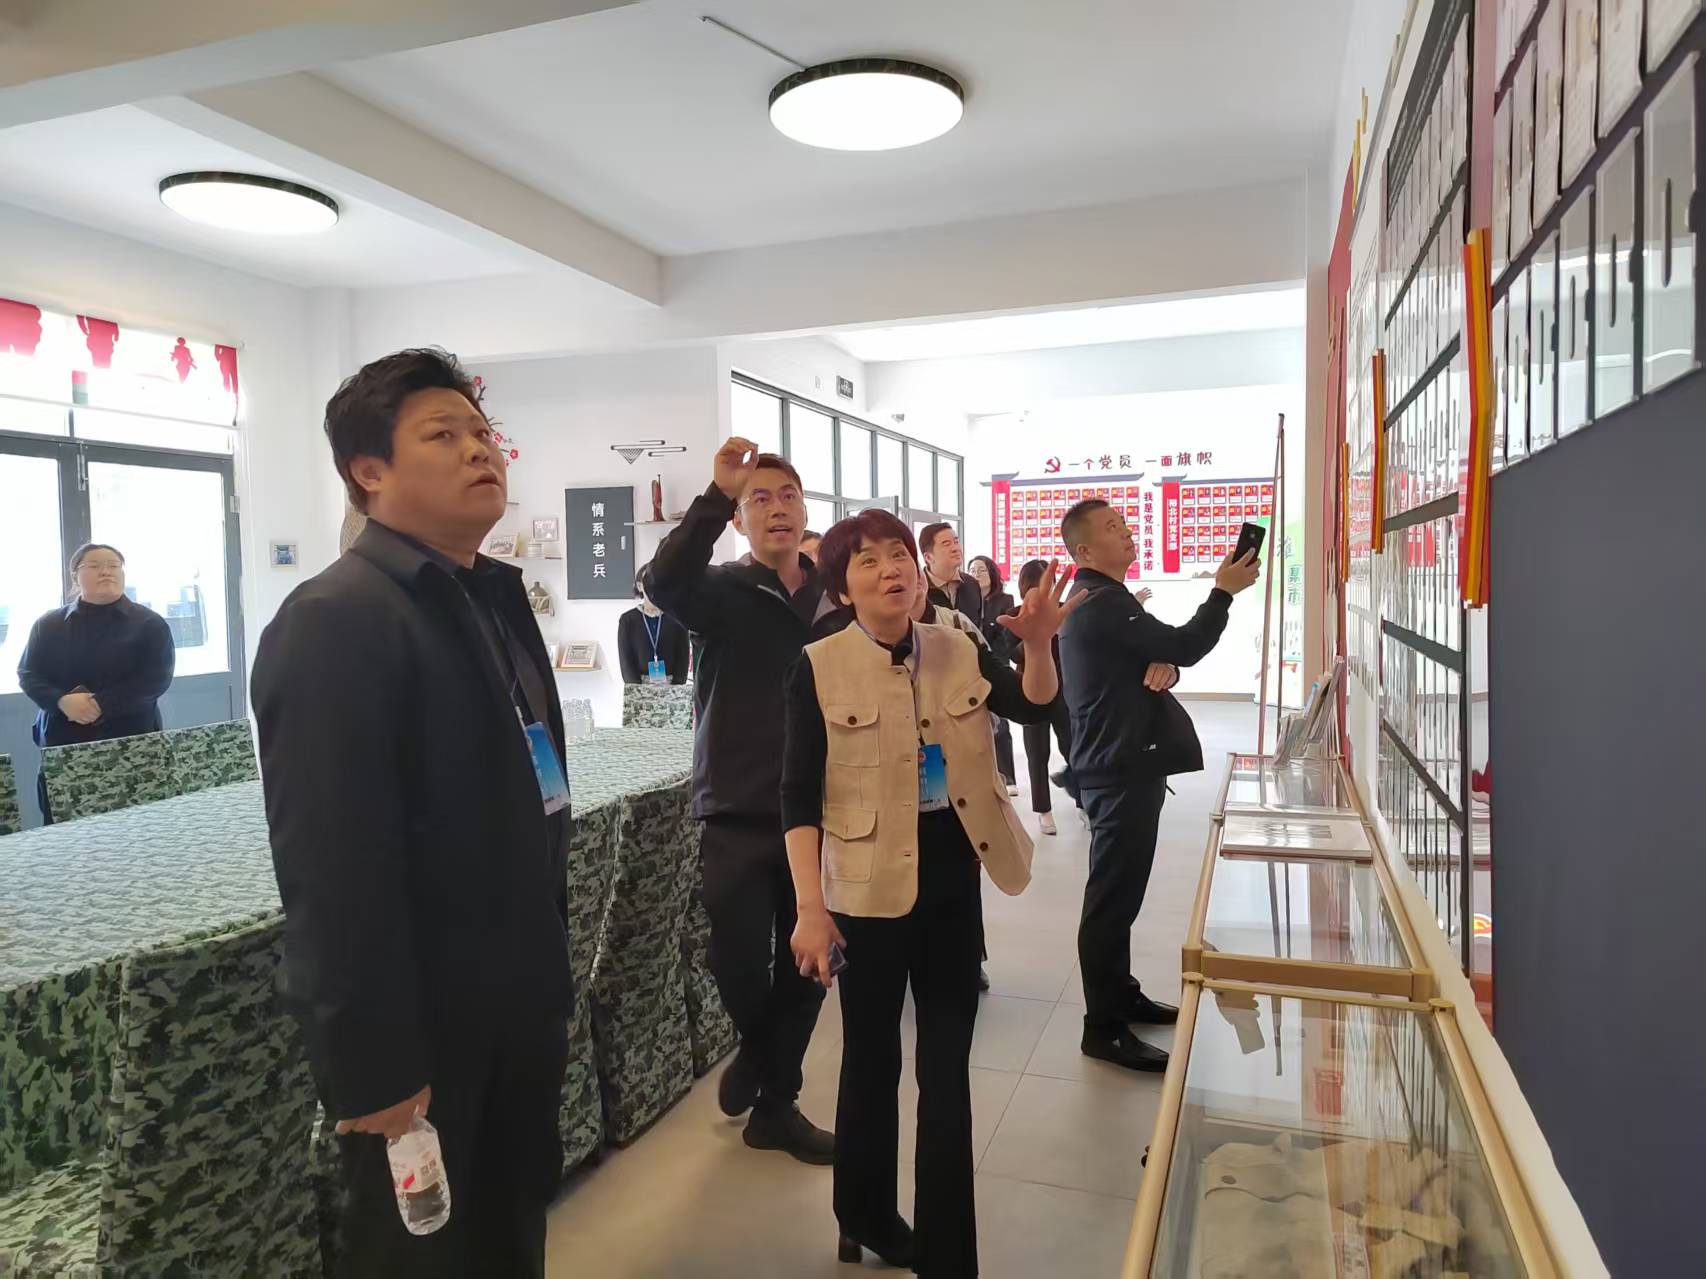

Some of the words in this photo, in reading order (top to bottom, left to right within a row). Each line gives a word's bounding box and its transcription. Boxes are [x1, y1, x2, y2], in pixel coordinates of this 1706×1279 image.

[1068, 454, 1132, 471] 一个党员
[1145, 451, 1213, 467] 一面旗帜
[1144, 491, 1153, 535] 我是党员
[591, 502, 606, 578] 情系老兵
[1143, 538, 1153, 571] 我承诺
